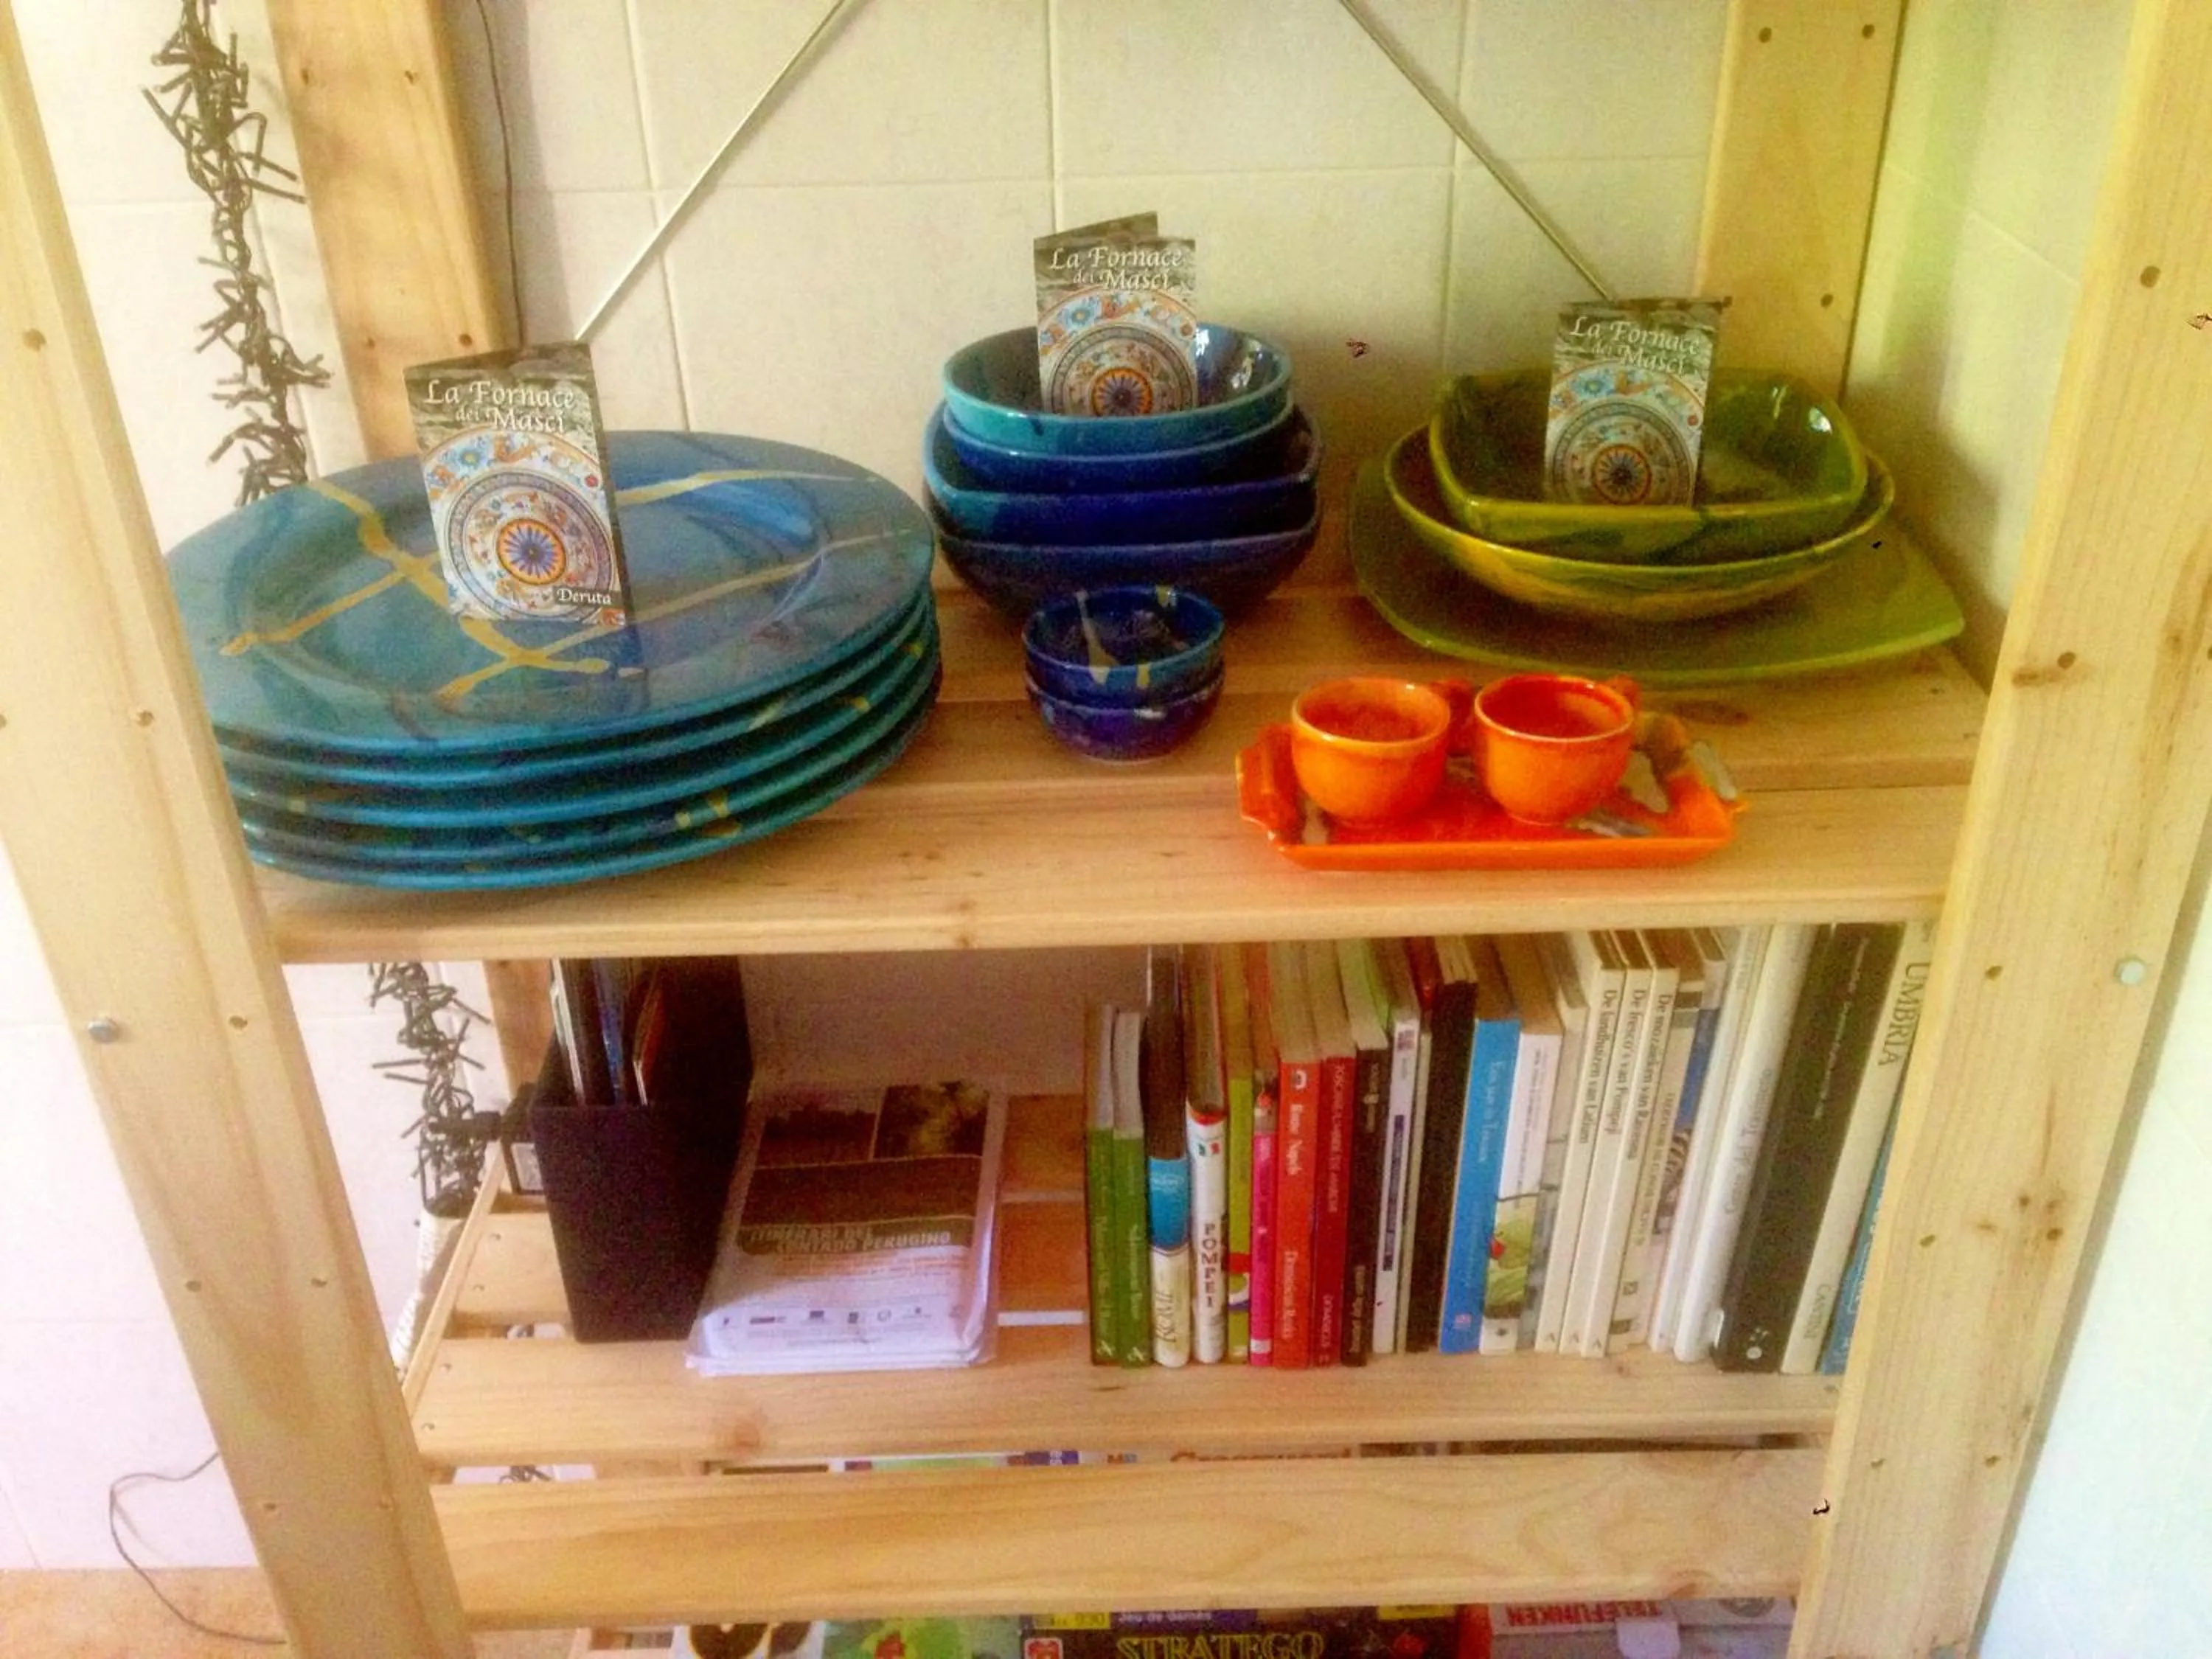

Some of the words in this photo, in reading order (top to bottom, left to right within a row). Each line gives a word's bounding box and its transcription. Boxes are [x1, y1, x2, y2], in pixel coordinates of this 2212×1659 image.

[1050, 247, 1079, 270] La
[1088, 246, 1182, 268] Fornace
[1073, 268, 1095, 284] dei
[1099, 268, 1169, 291] Masci
[1569, 316, 1600, 338] La
[1610, 319, 1700, 355] Fornace
[1617, 344, 1686, 375] Masci
[424, 379, 460, 404] La
[468, 380, 575, 408] Fornace
[455, 406, 480, 422] dei
[485, 407, 565, 434] Masci
[556, 588, 611, 605] Deruta
[1601, 989, 1618, 1007] De
[1630, 989, 1647, 1007] De
[1658, 994, 1672, 1013] De
[1877, 961, 1932, 1066] UMBRIA
[1616, 1060, 1630, 1084] van
[1585, 1080, 1599, 1105] van
[1638, 1085, 1652, 1108] van
[1200, 1223, 1218, 1308] POMPEI
[1505, 1600, 1663, 1627] TELEFUNKEN
[1116, 1632, 1326, 1659] STRATEGO
